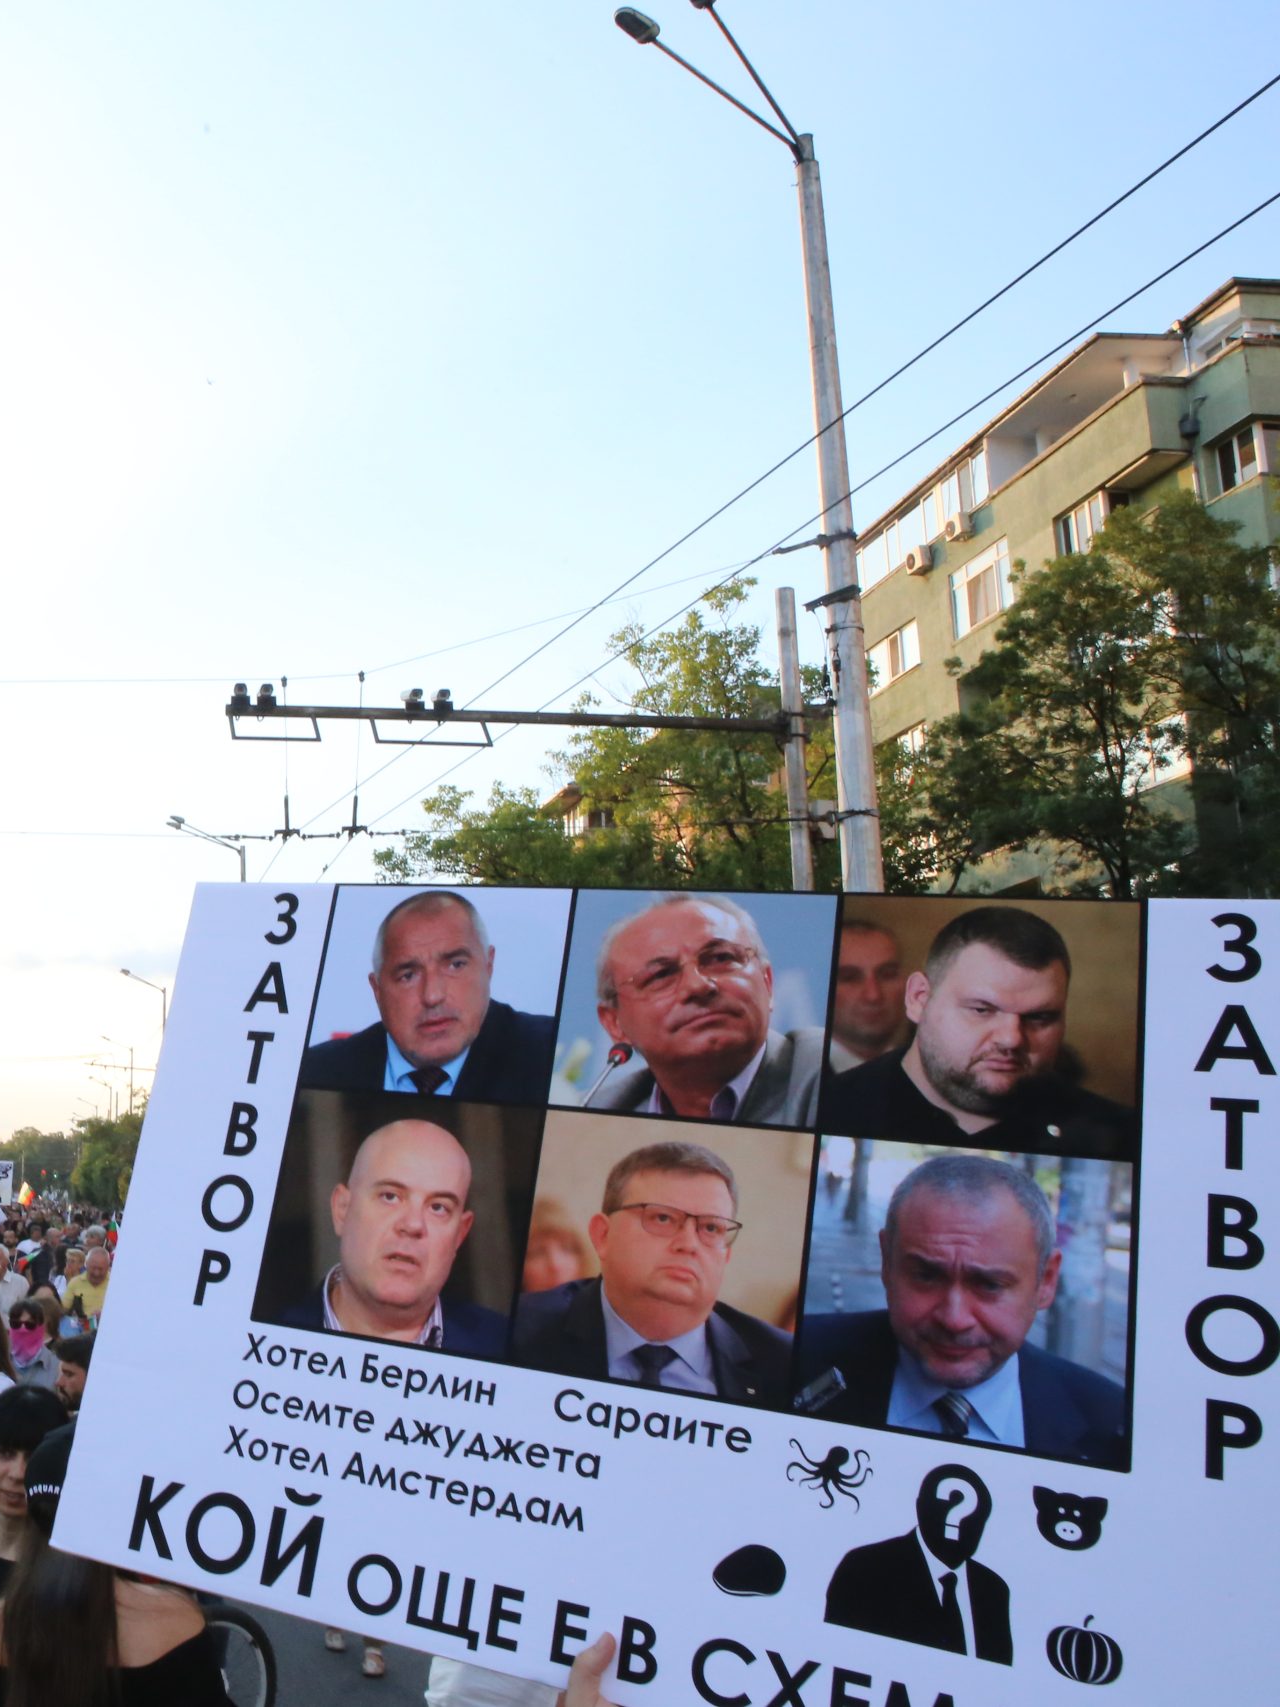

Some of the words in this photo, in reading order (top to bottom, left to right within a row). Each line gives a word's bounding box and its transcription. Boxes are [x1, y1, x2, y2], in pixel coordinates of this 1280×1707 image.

[193, 891, 299, 1306] ЗАТВОР
[1184, 912, 1280, 1481] ЗАТВОР
[242, 1332, 347, 1380] Хотел
[360, 1352, 497, 1407] Берлин
[554, 1388, 752, 1453] Сараите
[224, 1425, 329, 1476] Хотел
[341, 1451, 584, 1533] Амстердам
[233, 1379, 375, 1434] Осемте
[384, 1417, 601, 1481] джуджета
[128, 1474, 325, 1598] КОЙ
[347, 1553, 525, 1653] ОЩЕ
[549, 1599, 590, 1669] Е
[616, 1615, 658, 1685] В
